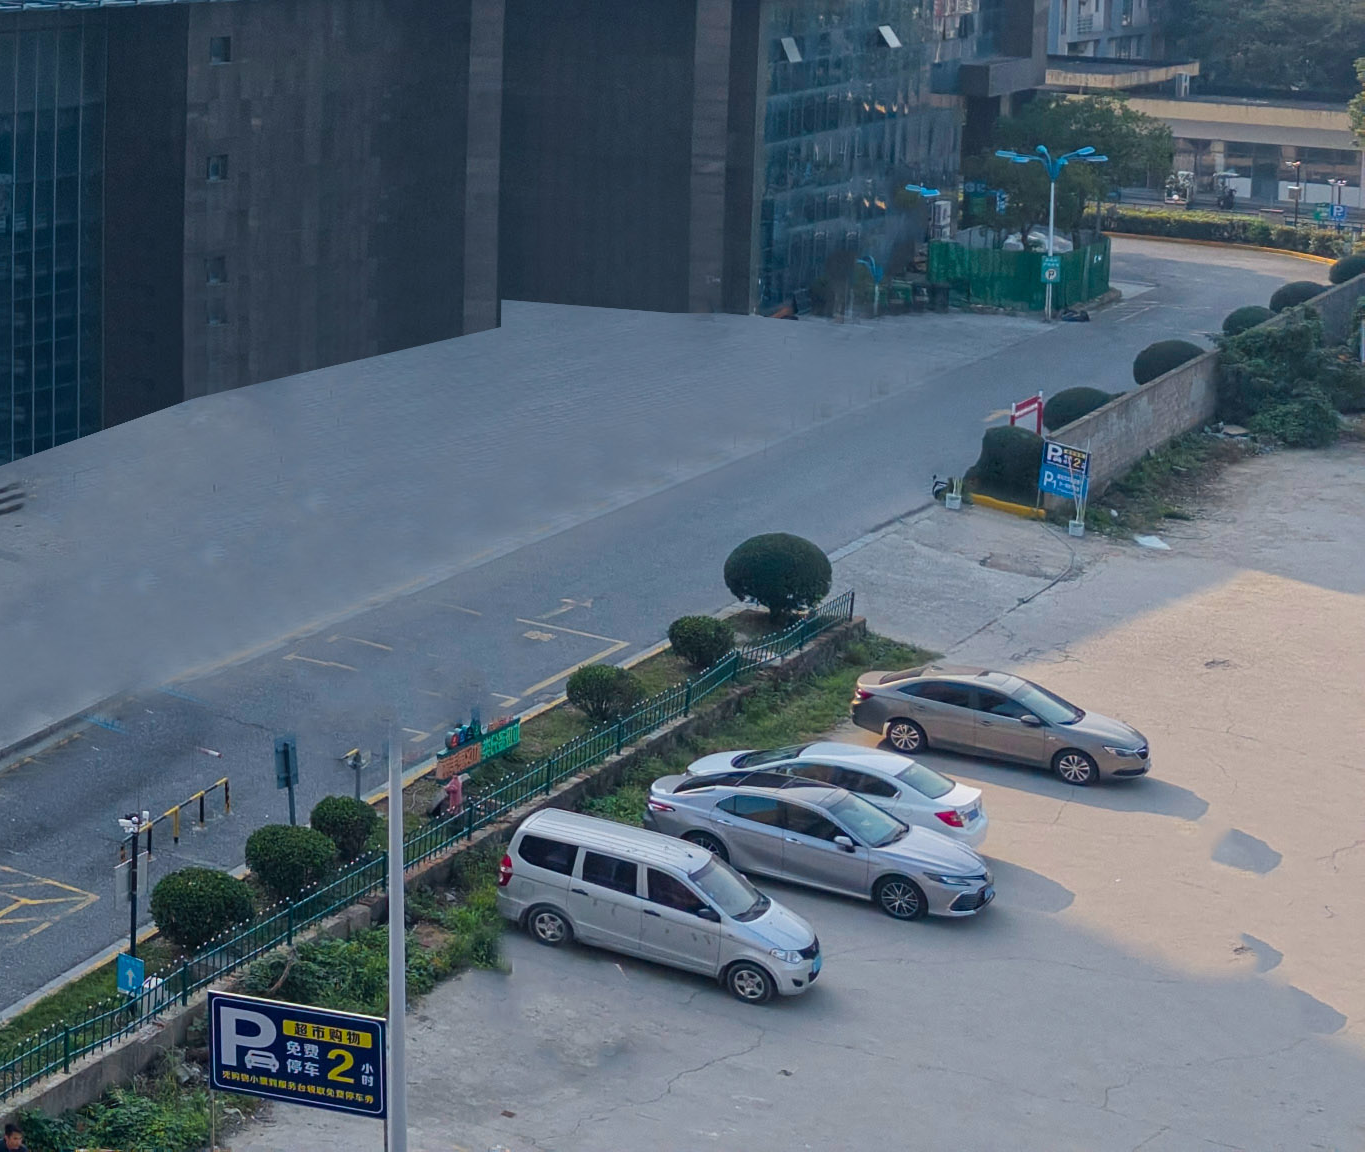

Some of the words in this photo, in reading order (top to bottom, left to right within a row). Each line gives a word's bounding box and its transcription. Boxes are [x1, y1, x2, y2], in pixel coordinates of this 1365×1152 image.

[220, 1006, 277, 1067] P
[294, 1022, 361, 1046] 超市购物
[286, 1041, 320, 1060] 免费
[286, 1058, 320, 1077] 停车
[327, 1049, 355, 1084] 2
[361, 1063, 374, 1087] 小时
